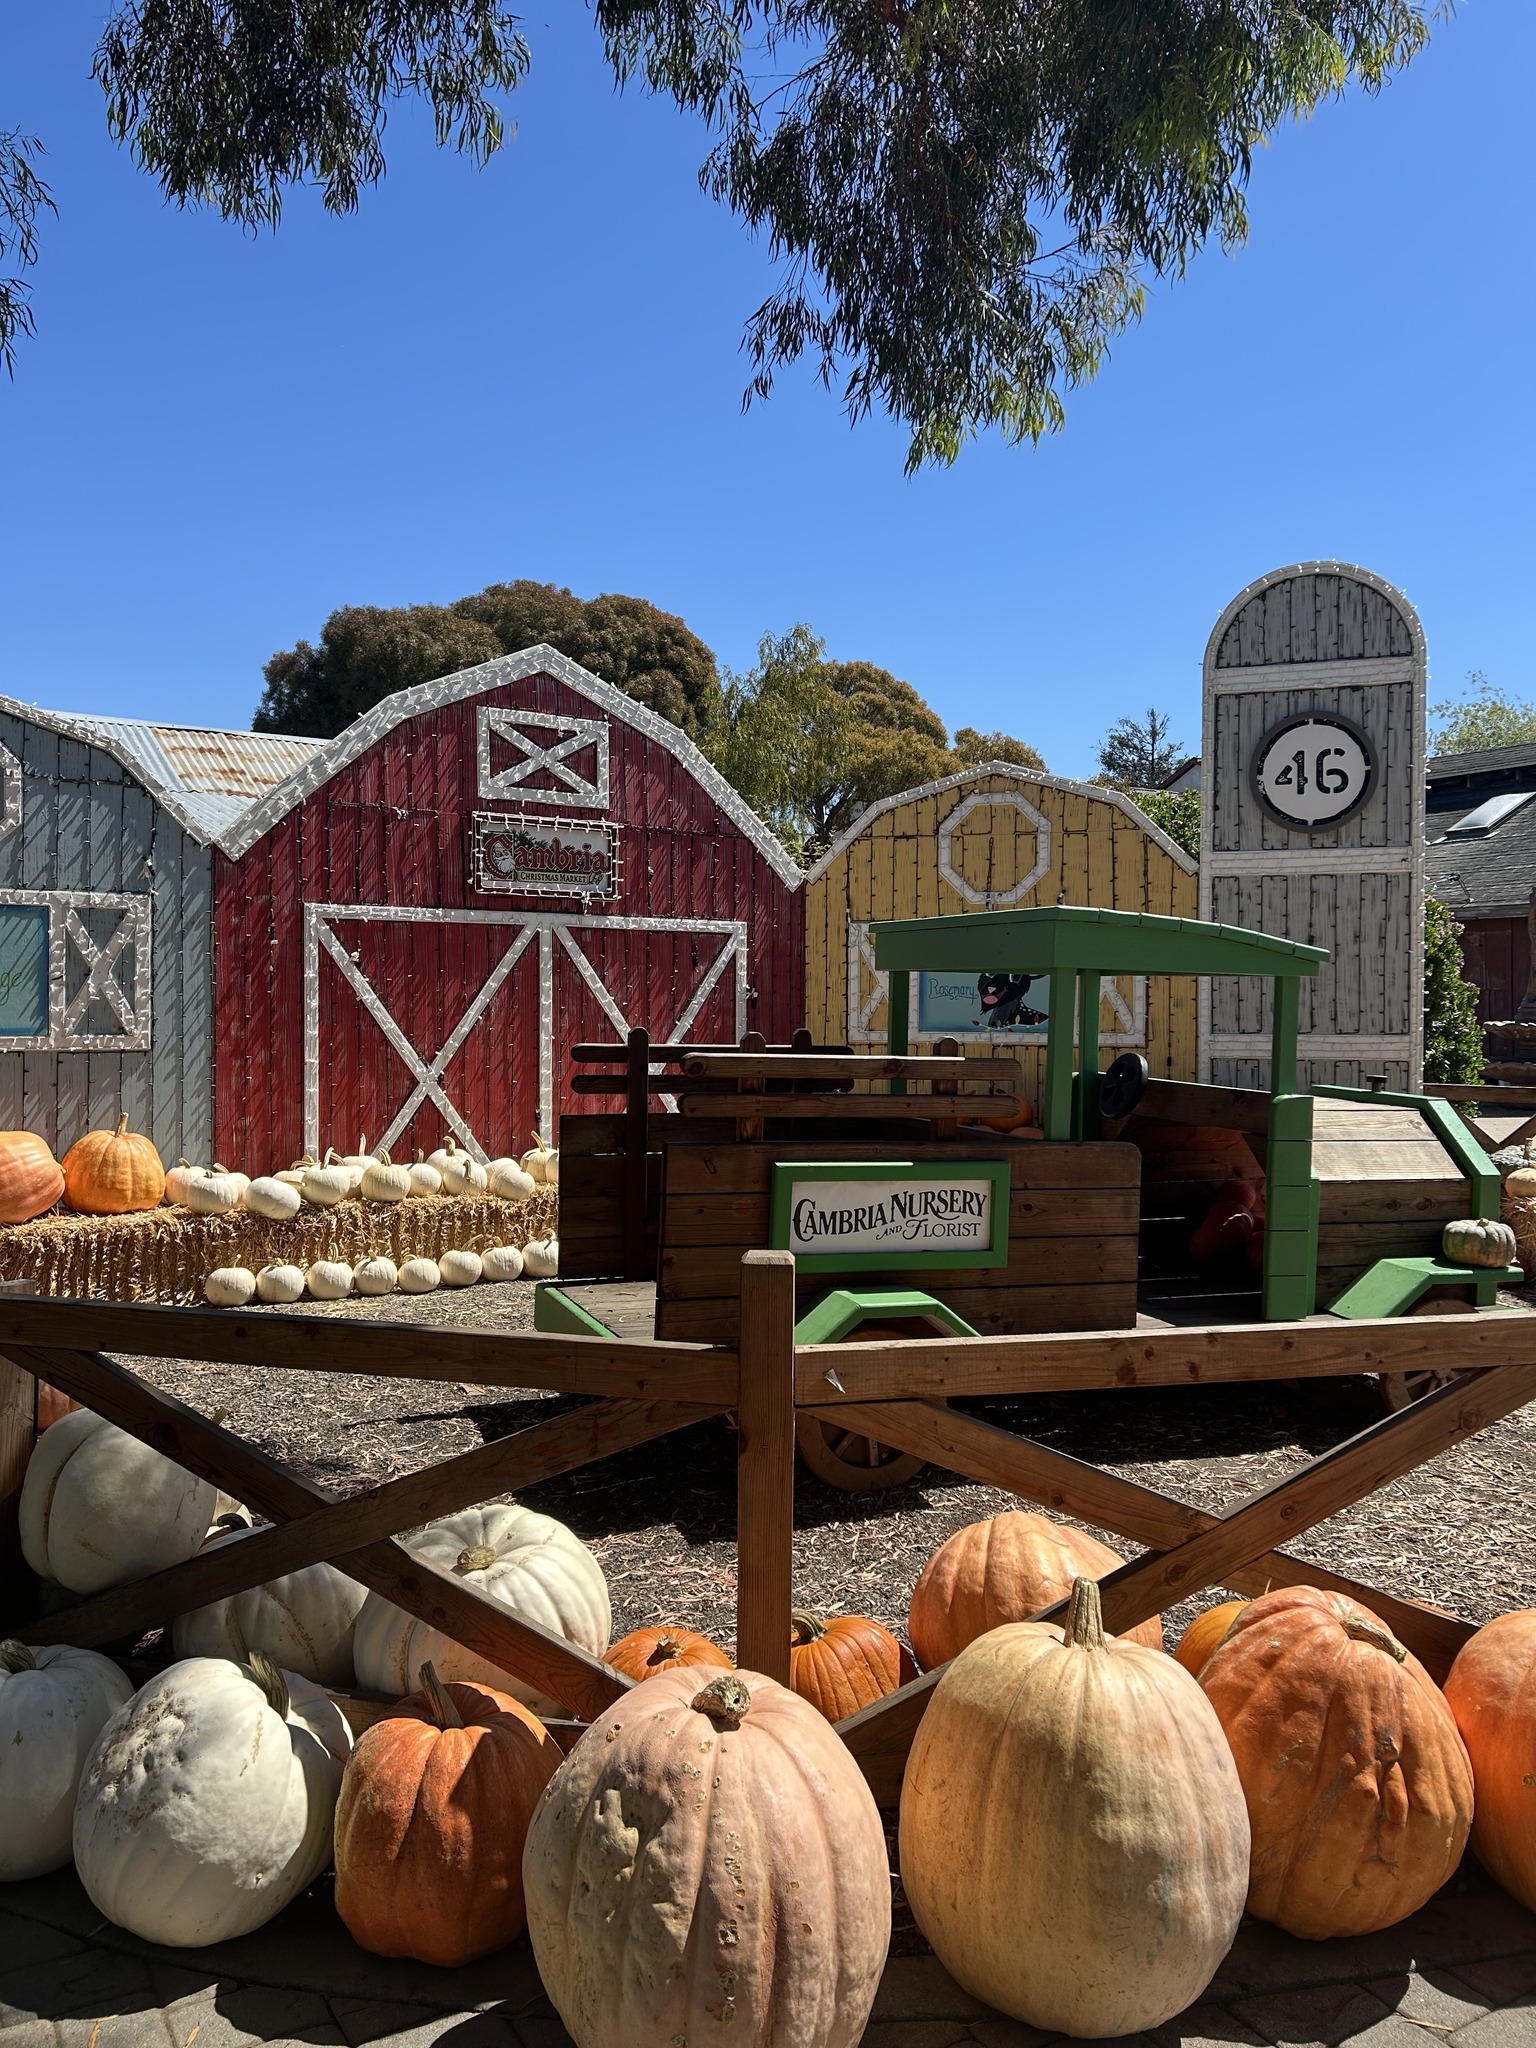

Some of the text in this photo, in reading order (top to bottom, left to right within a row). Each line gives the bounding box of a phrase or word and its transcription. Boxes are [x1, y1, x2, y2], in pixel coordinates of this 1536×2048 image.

[1275, 748, 1349, 795] 46
[482, 834, 607, 880] Cambria
[520, 872, 586, 883] CHRISTMAS MARKET
[928, 978, 979, 1005] Rosemary
[792, 1189, 987, 1242] CAMBRIA NURSERY
[876, 1218, 981, 1240] AND FLORIST
